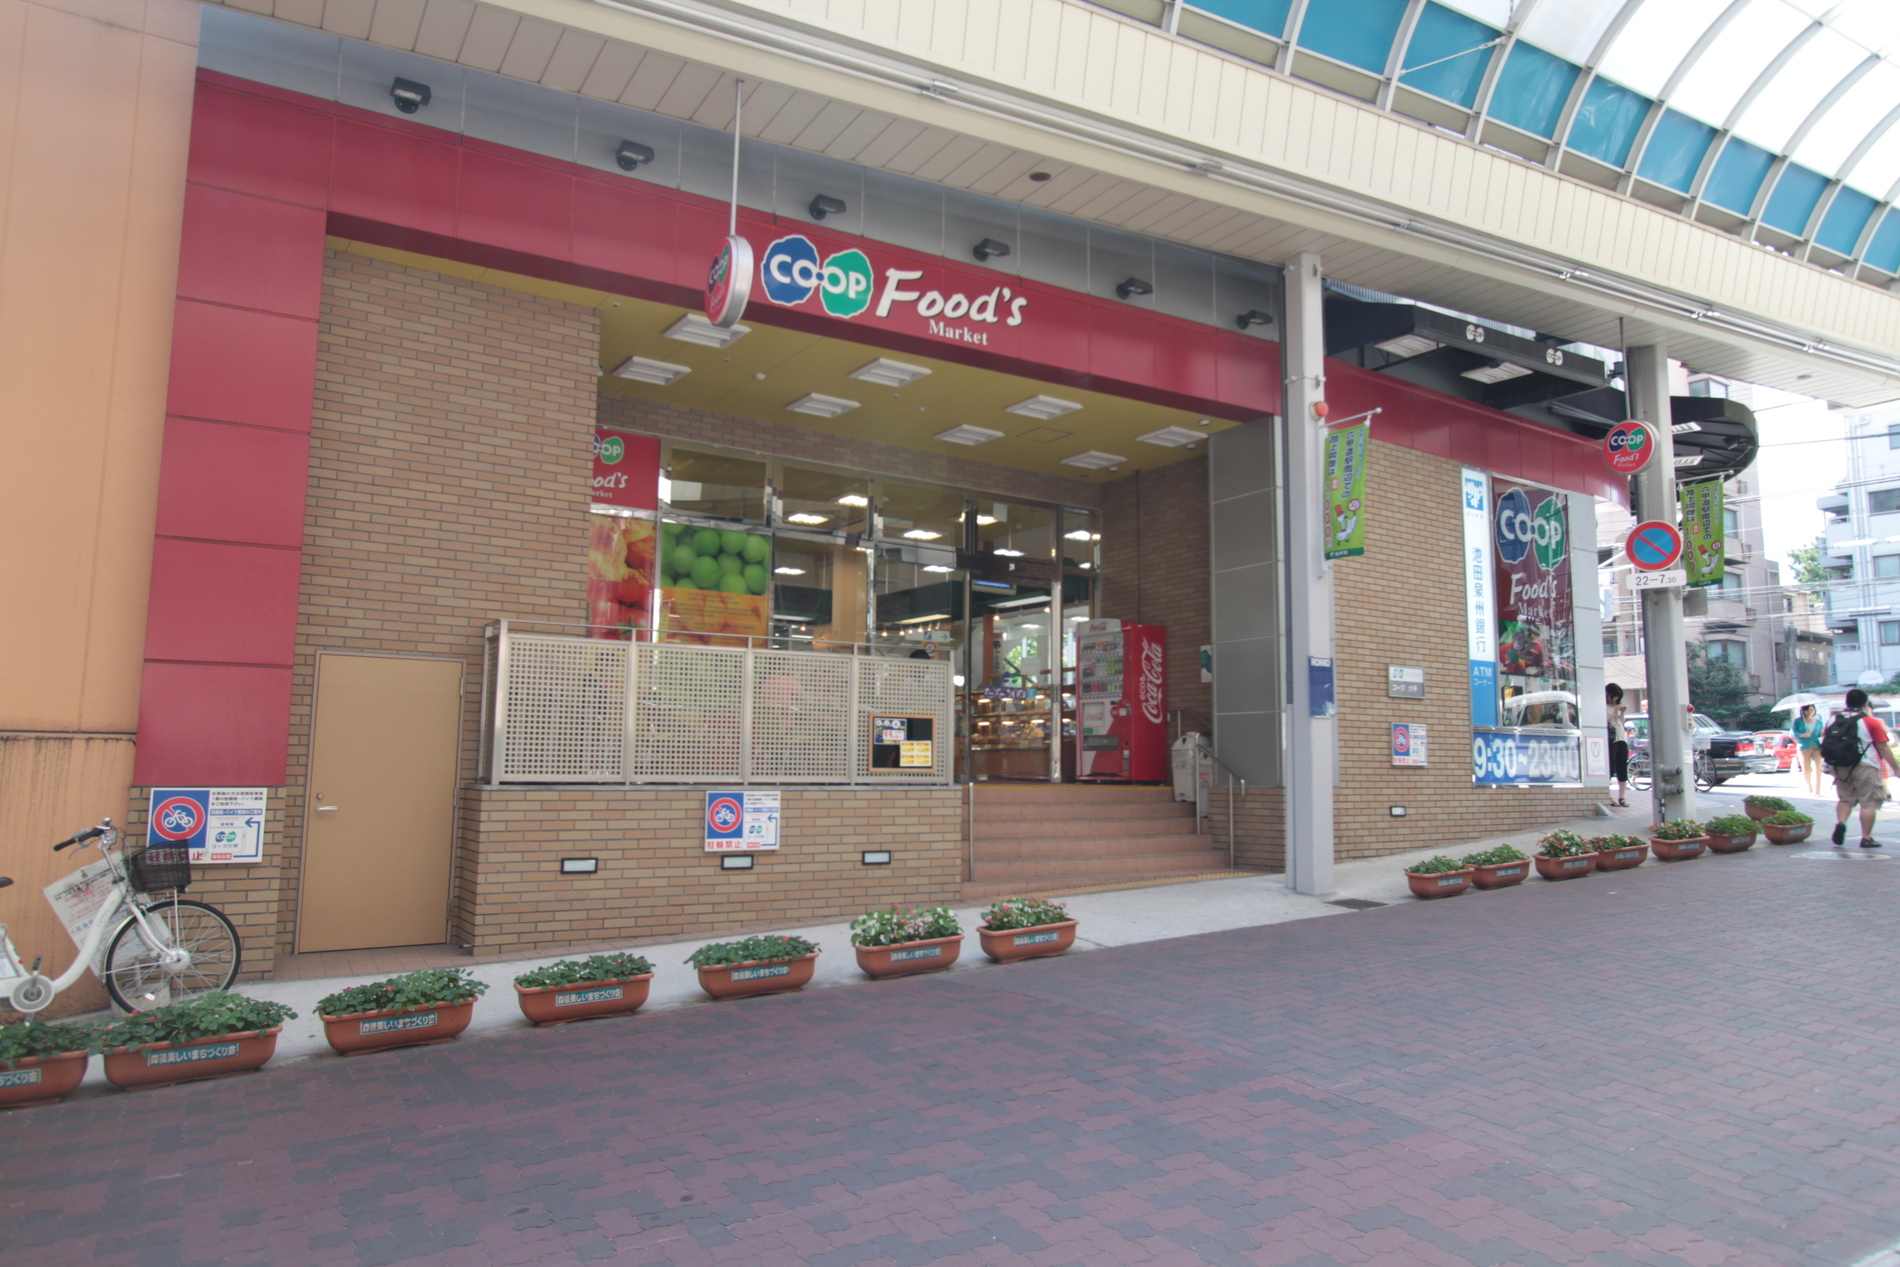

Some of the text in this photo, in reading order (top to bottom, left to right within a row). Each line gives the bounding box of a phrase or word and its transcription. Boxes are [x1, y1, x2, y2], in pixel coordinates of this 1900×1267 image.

[876, 268, 1028, 327] Food's
[928, 319, 989, 346] Market
[1613, 452, 1640, 466] Food's
[592, 472, 629, 489] od's
[1471, 546, 1487, 654] 池田泉州銀行
[1509, 572, 1558, 606] Food's
[1141, 636, 1164, 725] Coca-Cola
[1473, 666, 1493, 678] ATM
[1473, 678, 1493, 687] コーナー
[150, 1045, 237, 1065] 森後美しいまちづくり会
